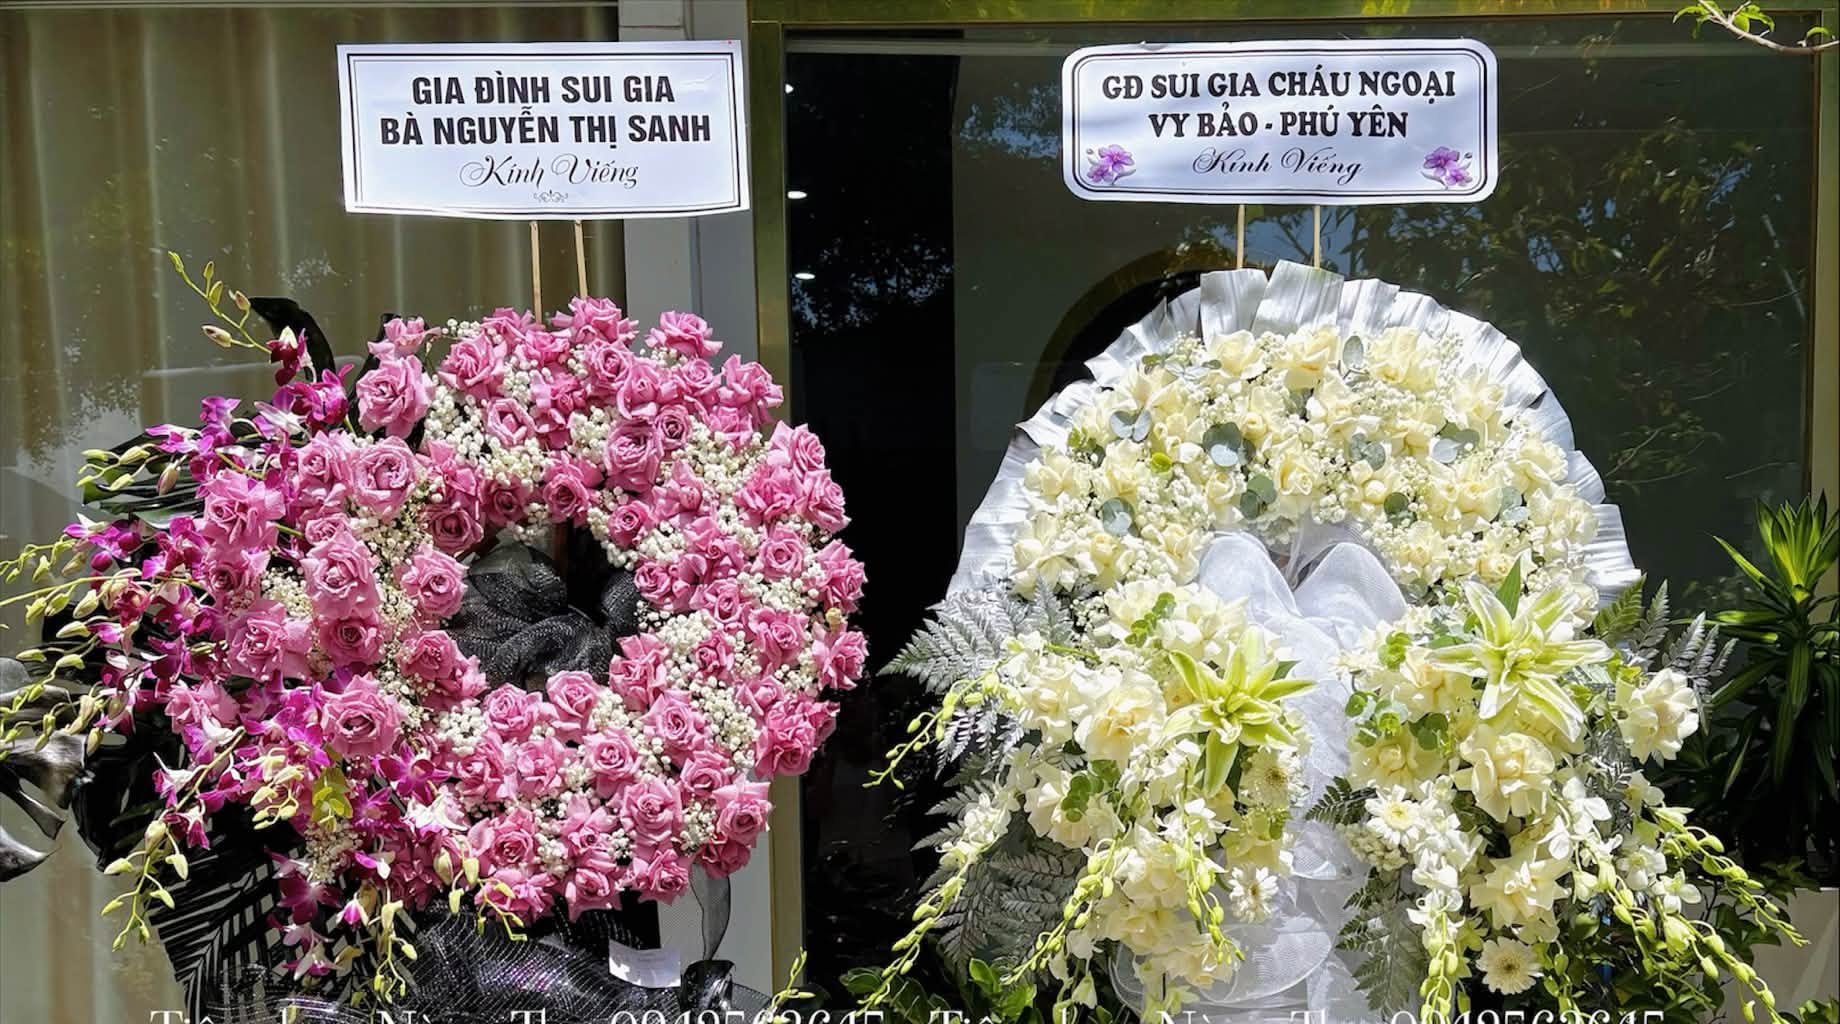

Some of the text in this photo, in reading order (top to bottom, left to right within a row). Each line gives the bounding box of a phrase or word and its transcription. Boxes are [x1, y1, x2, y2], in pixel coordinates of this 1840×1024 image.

[412, 70, 675, 105] GIA ĐÌNH SUI GIA
[1102, 64, 1456, 104] GĐ SUI GIA CHÁU NGOẠI
[381, 105, 711, 149] BÀ NGUYỄN THỊ SANH
[1148, 113, 1189, 138] VY
[1197, 101, 1258, 137] BẢO
[1280, 104, 1340, 136] PHÚ
[1347, 104, 1409, 138] YÊN
[459, 153, 639, 189] Kính Viếng
[1280, 146, 1363, 186] Viếng
